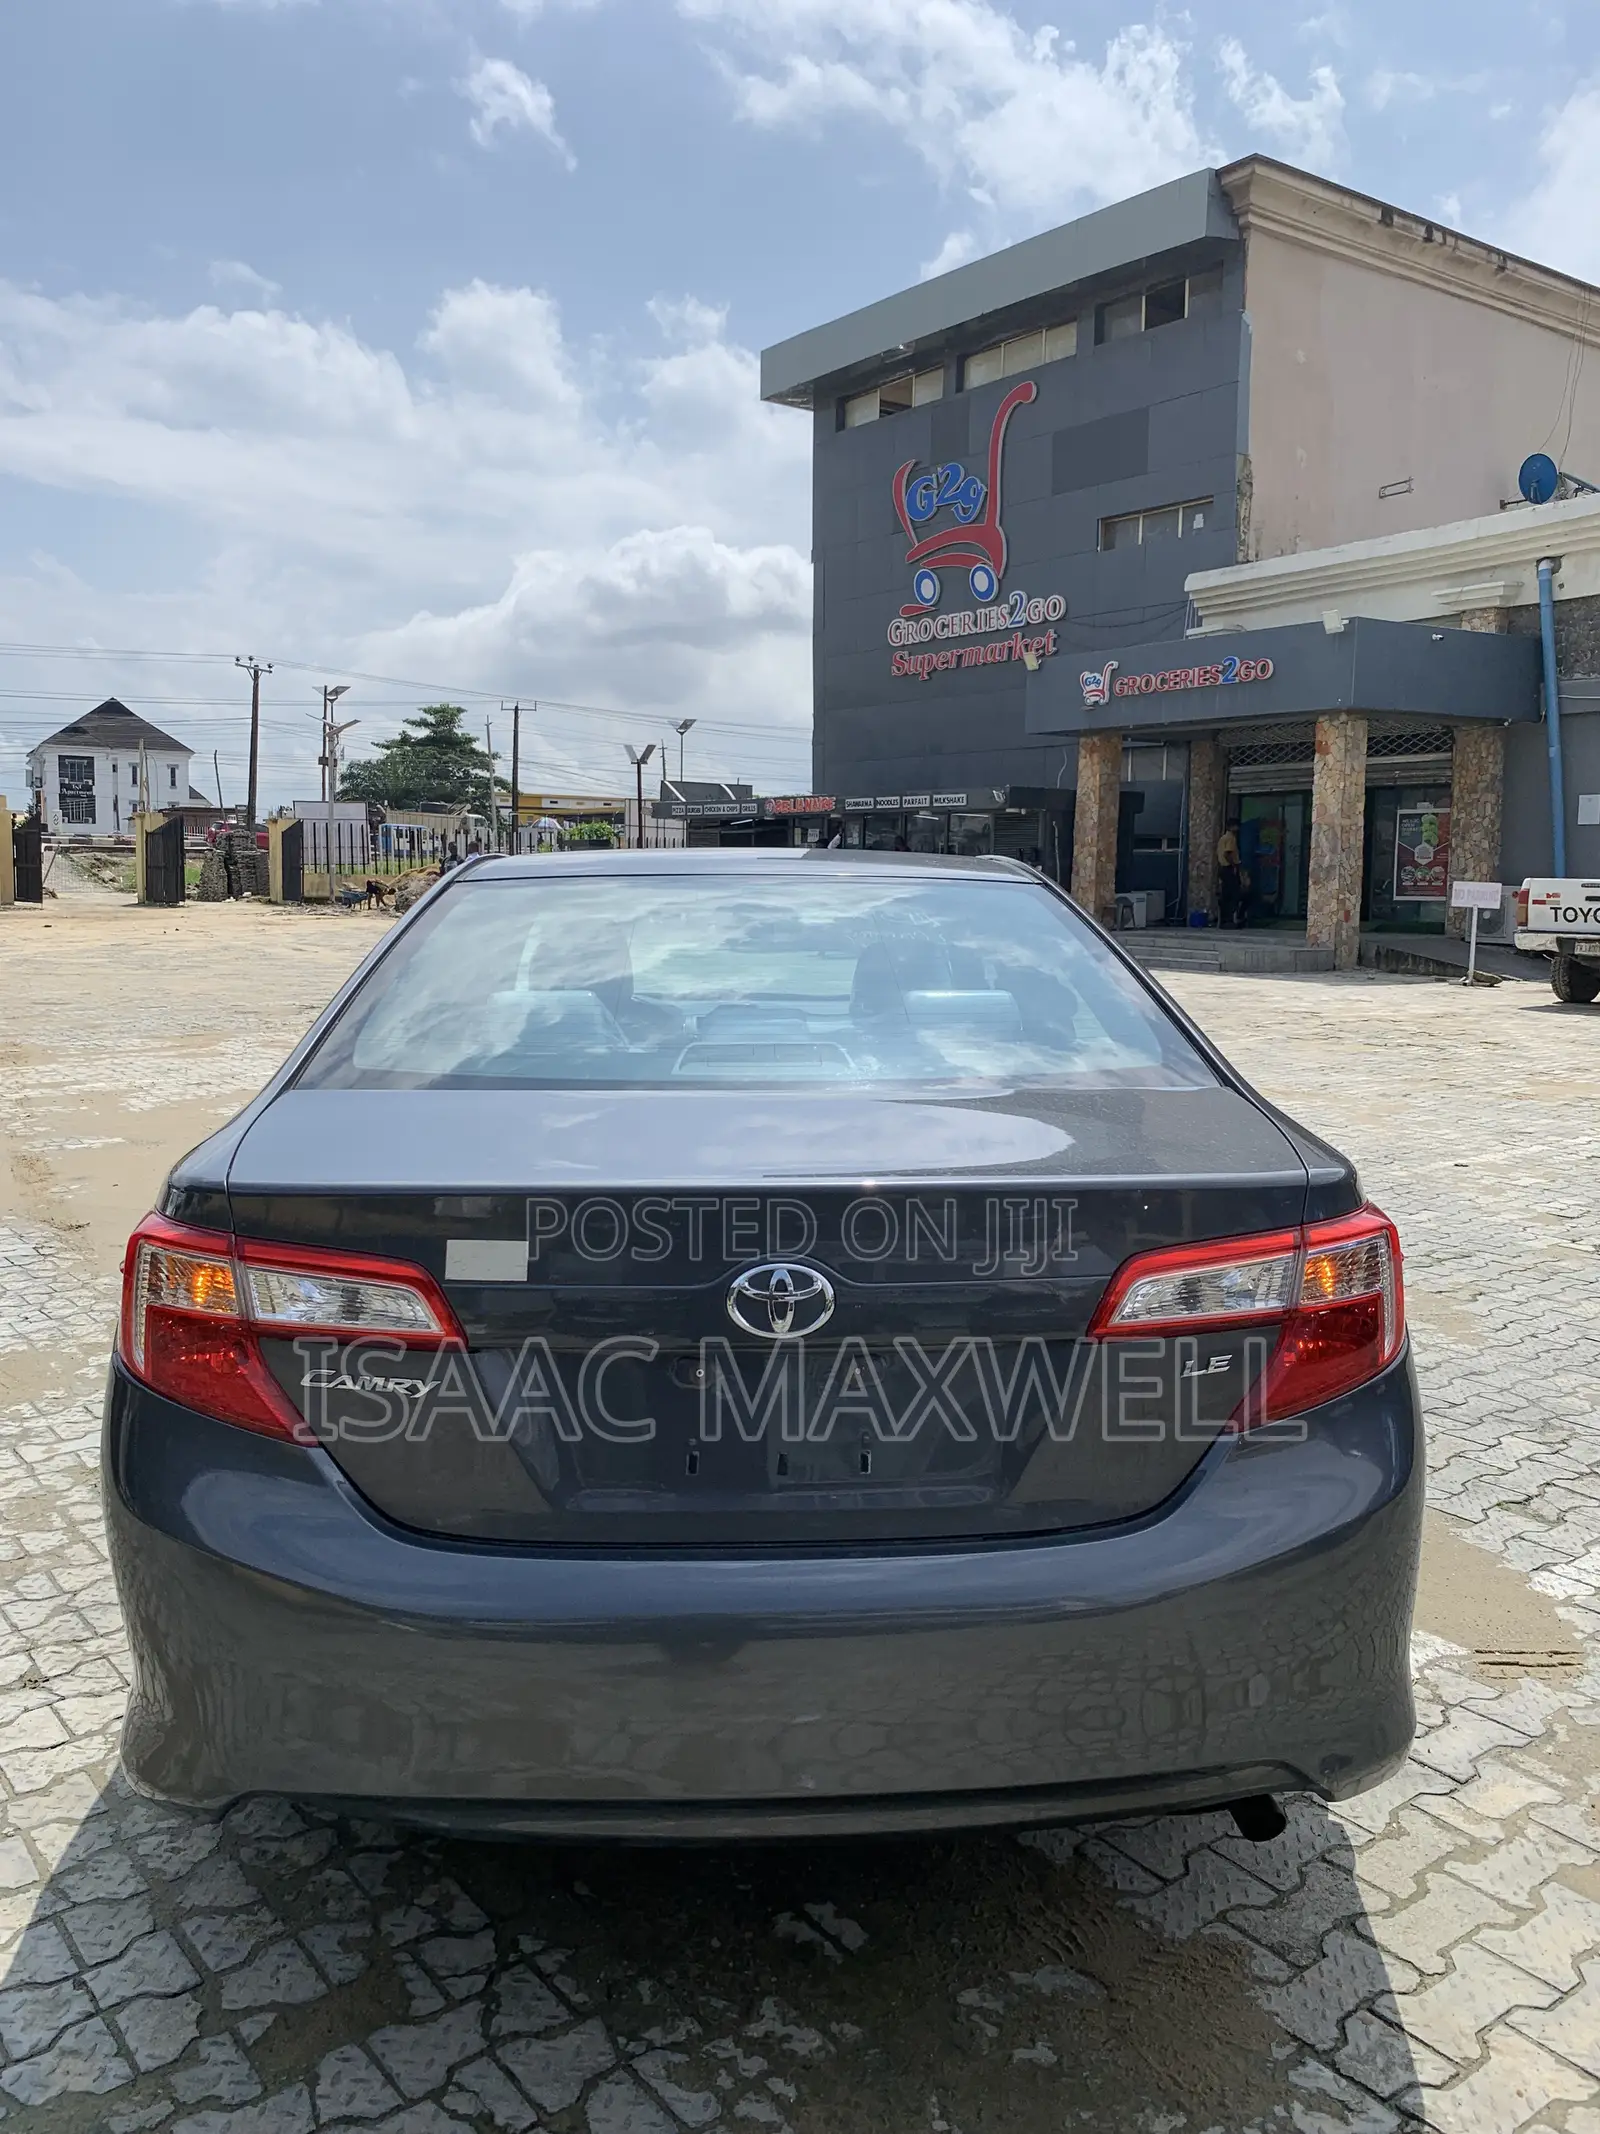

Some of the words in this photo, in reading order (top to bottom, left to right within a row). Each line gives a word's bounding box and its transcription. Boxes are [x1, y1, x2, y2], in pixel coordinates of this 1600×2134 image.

[891, 628, 1058, 681] Supermarket
[1113, 656, 1273, 697] GROCERIES2GO
[845, 800, 872, 808] SHAWARMA
[877, 798, 899, 806] NOODLES
[903, 797, 928, 806] PARFAIT
[933, 796, 965, 804] MILKSHAKE
[672, 806, 685, 814] PIZZA
[704, 805, 722, 813] CHICKEN
[742, 804, 756, 812] GRILLS
[1180, 1354, 1233, 1378] LE
[300, 1369, 442, 1398] CAMRY
